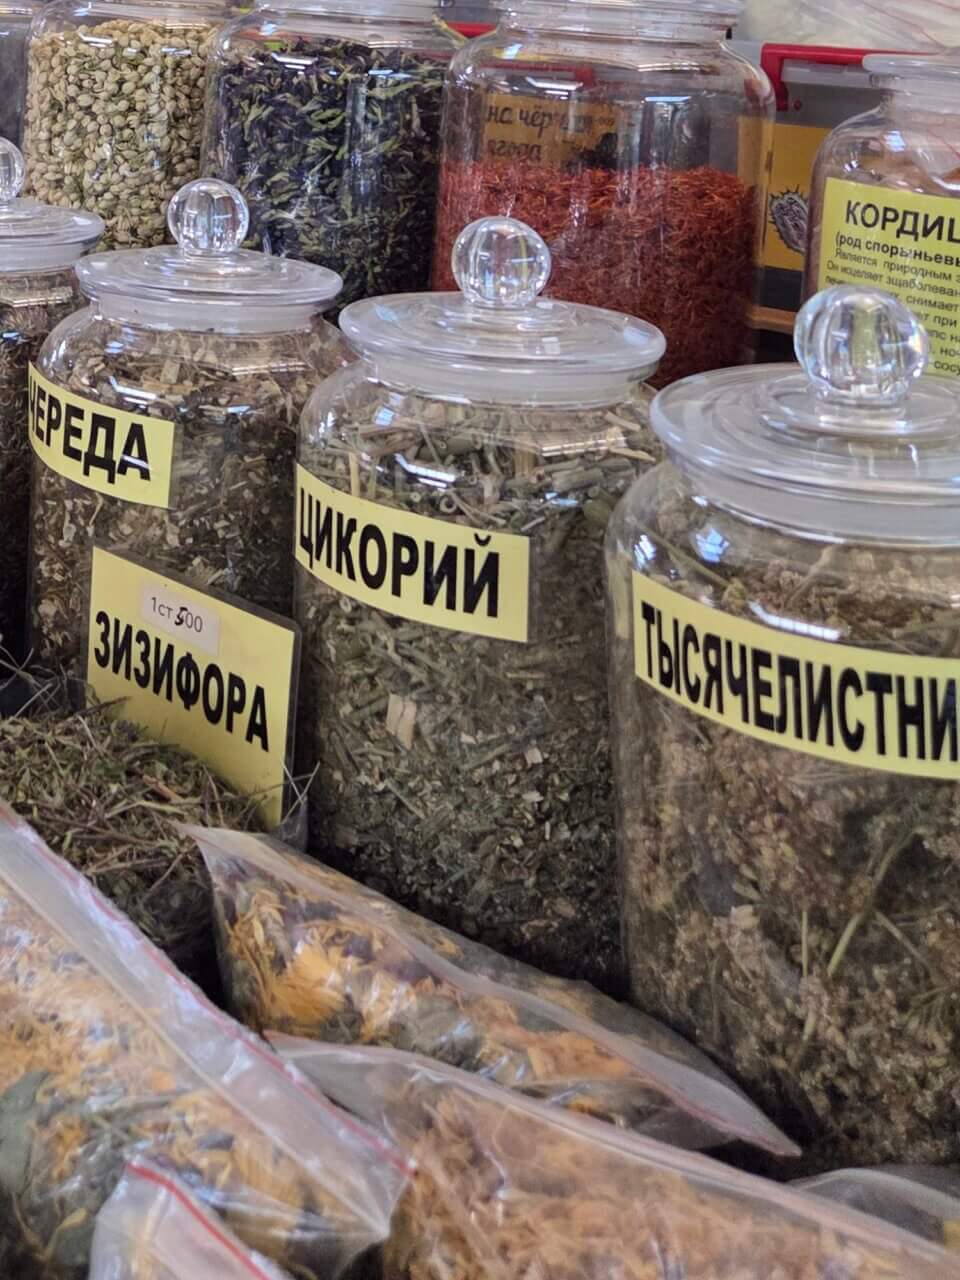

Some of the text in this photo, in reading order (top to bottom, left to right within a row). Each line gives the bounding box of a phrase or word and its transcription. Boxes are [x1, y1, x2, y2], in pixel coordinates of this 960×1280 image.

[151, 596, 203, 633] 1ст 500
[299, 486, 499, 618] ЦИКОРИЙ
[94, 610, 270, 752] ЗИЗИФОРА
